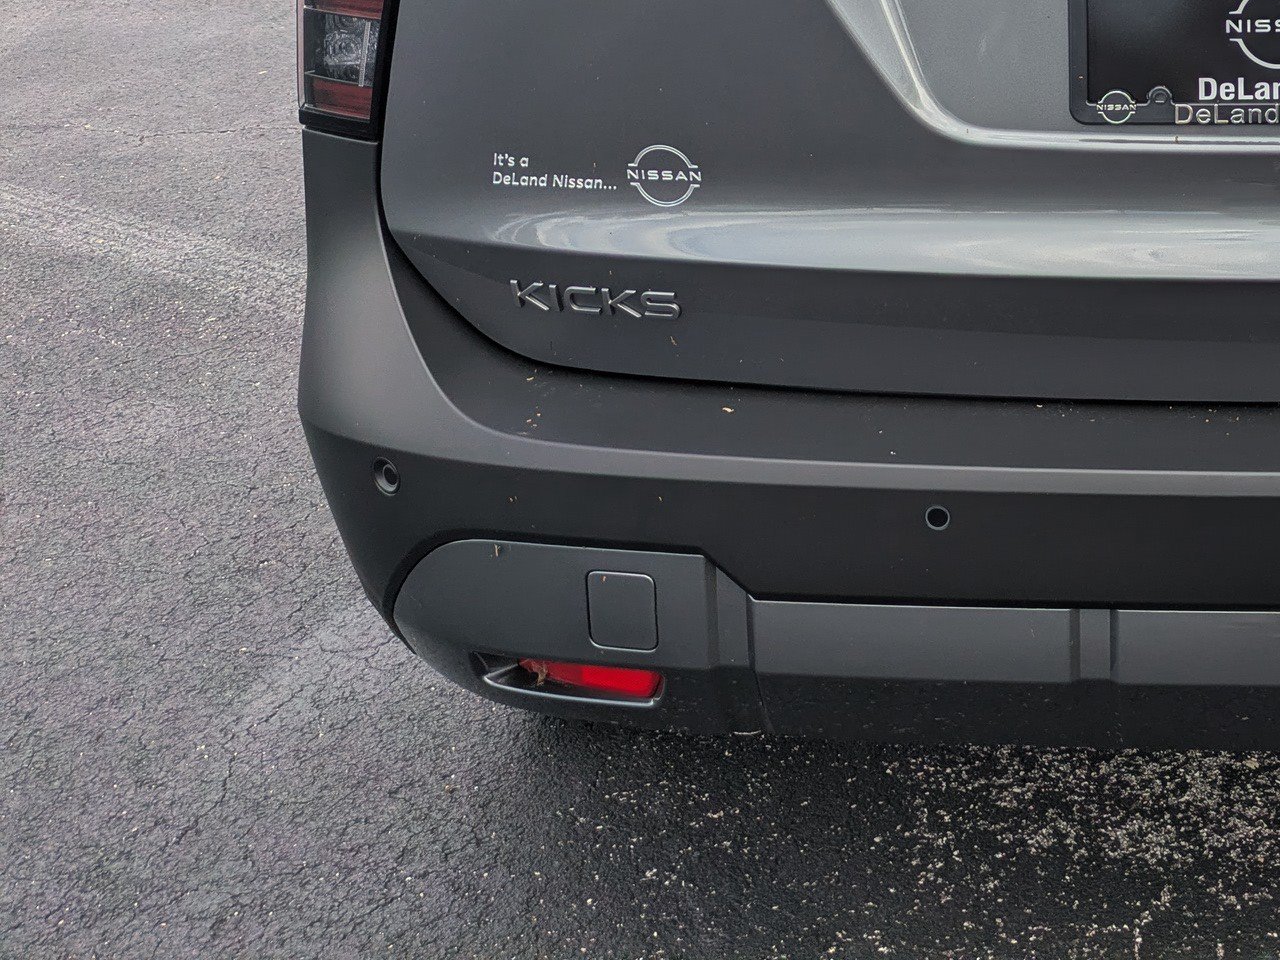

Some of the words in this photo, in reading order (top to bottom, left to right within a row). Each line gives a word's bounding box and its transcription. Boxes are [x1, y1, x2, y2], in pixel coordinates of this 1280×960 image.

[1096, 102, 1137, 111] NISSAN
[492, 152, 515, 168] It's
[519, 156, 530, 168] a
[492, 171, 548, 188] DeLand
[552, 174, 618, 190] Nissan...
[626, 168, 702, 182] NISSAN
[509, 278, 682, 320] KICKS
